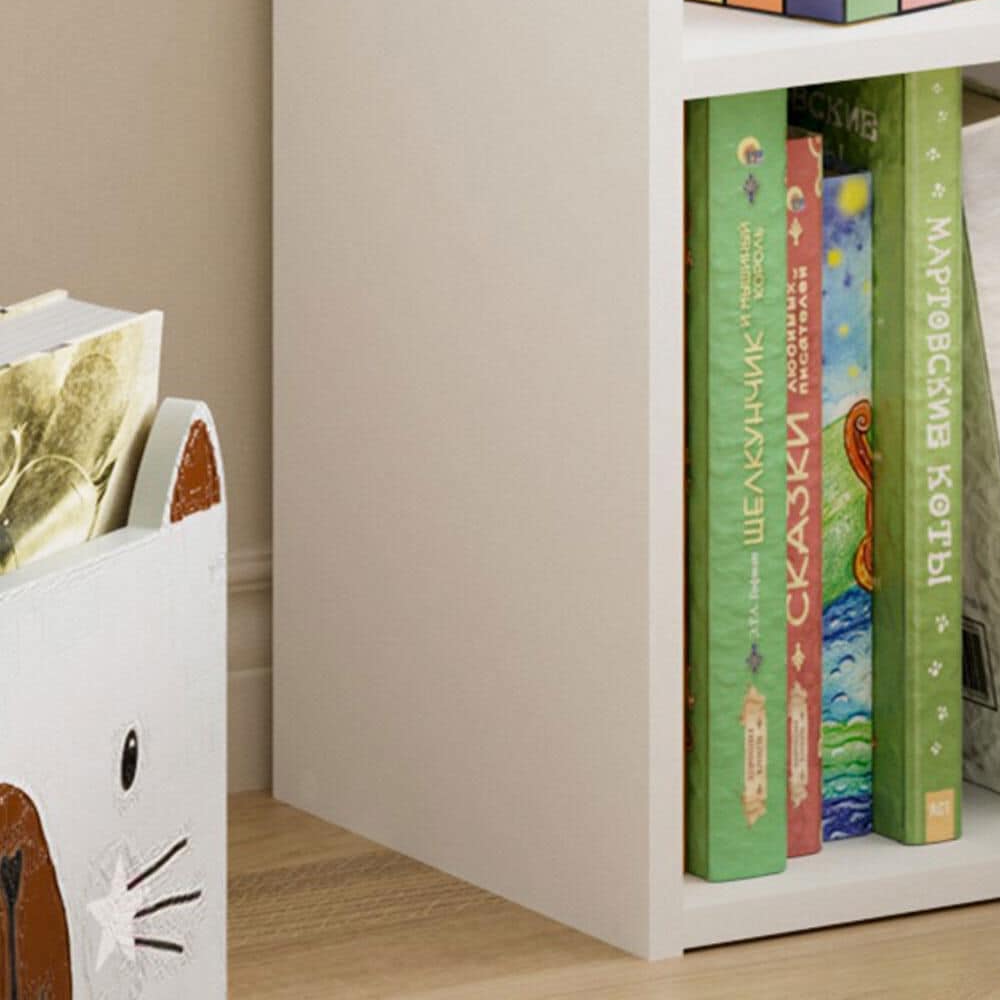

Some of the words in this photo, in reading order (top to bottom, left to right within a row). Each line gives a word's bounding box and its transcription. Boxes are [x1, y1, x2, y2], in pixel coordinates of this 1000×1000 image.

[744, 331, 764, 545] ЩЕЛКУНЧИК
[926, 217, 952, 449] МАРТОВСКИЕ
[787, 412, 810, 626] СКАЗКИ
[926, 465, 952, 586] КОТЫ
